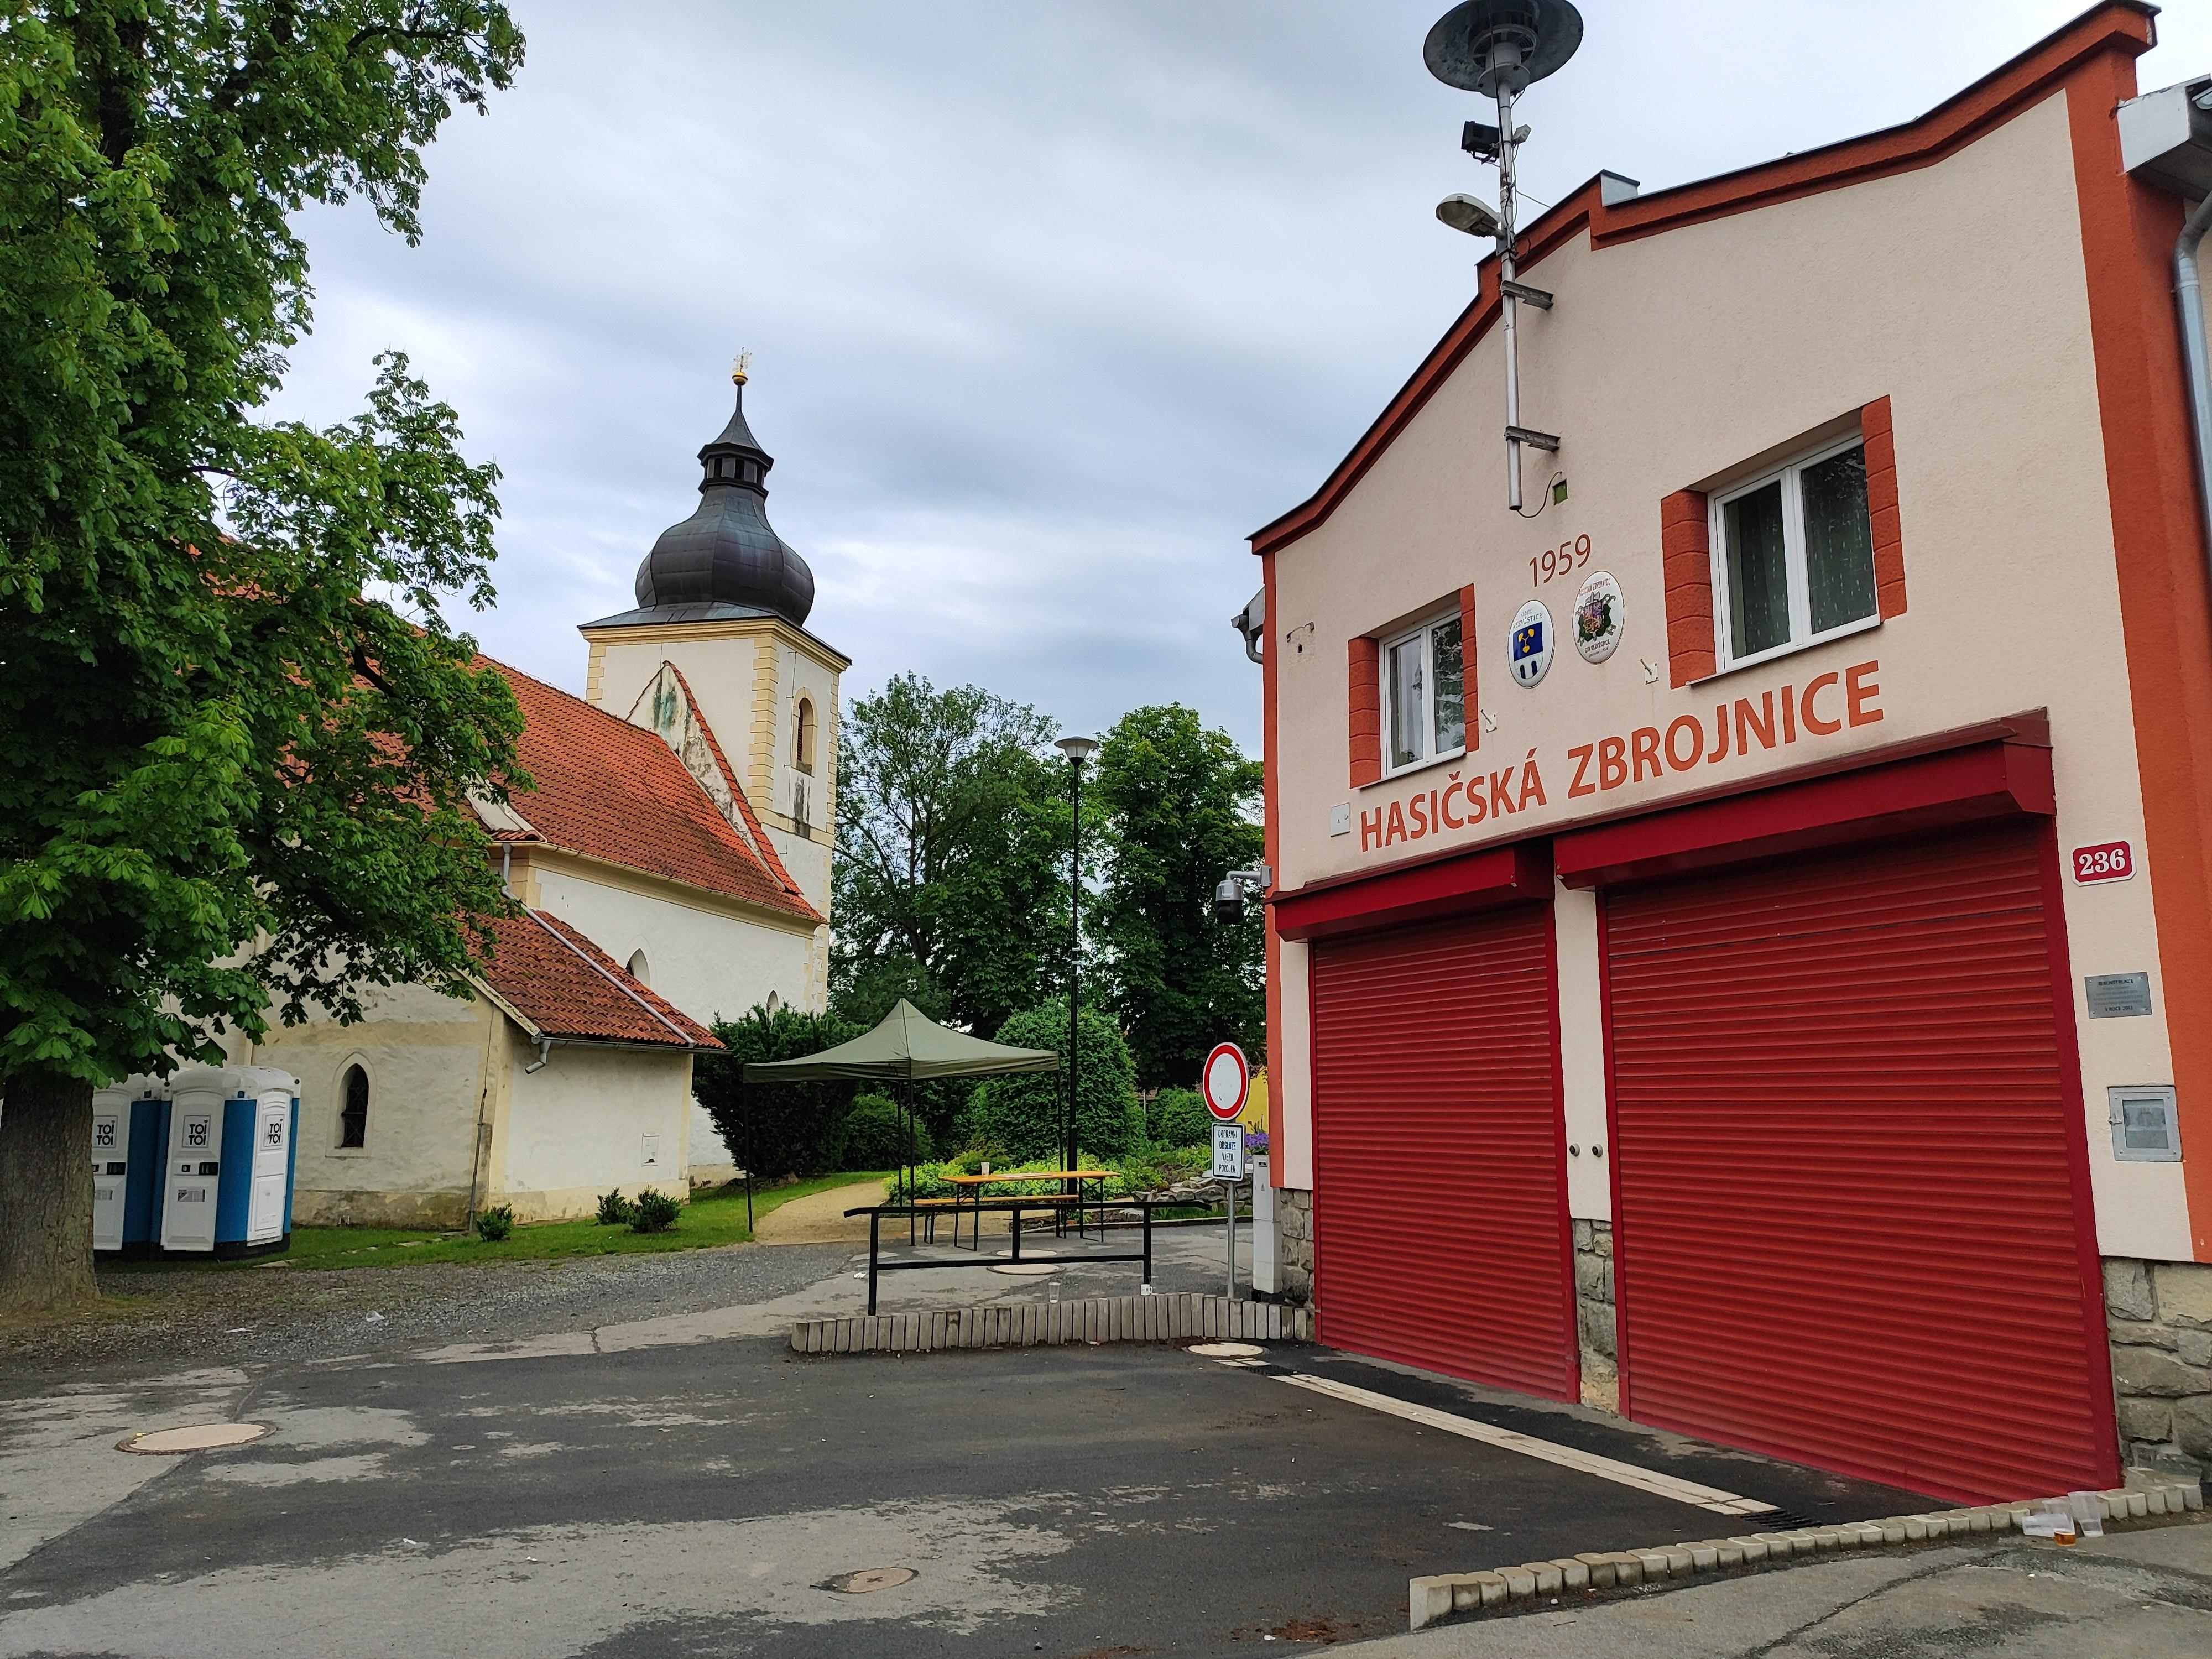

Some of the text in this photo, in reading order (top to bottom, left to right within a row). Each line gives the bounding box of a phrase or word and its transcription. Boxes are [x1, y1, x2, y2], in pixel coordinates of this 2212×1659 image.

[1529, 534, 1591, 587] 1959
[1361, 660, 1884, 852] HASIČSKÁ ZBROJNICE
[2079, 848, 2126, 875] 236
[97, 1120, 115, 1134] TOI
[189, 1120, 208, 1134] TOI
[269, 1119, 283, 1133] TOI
[96, 1135, 113, 1145] TOI
[189, 1135, 206, 1145] TOI
[268, 1134, 281, 1144] TOI
[1219, 1141, 1236, 1150] OBSLUZE
[1222, 1152, 1233, 1161] VJEZD
[1219, 1164, 1236, 1173] POVOLEN
